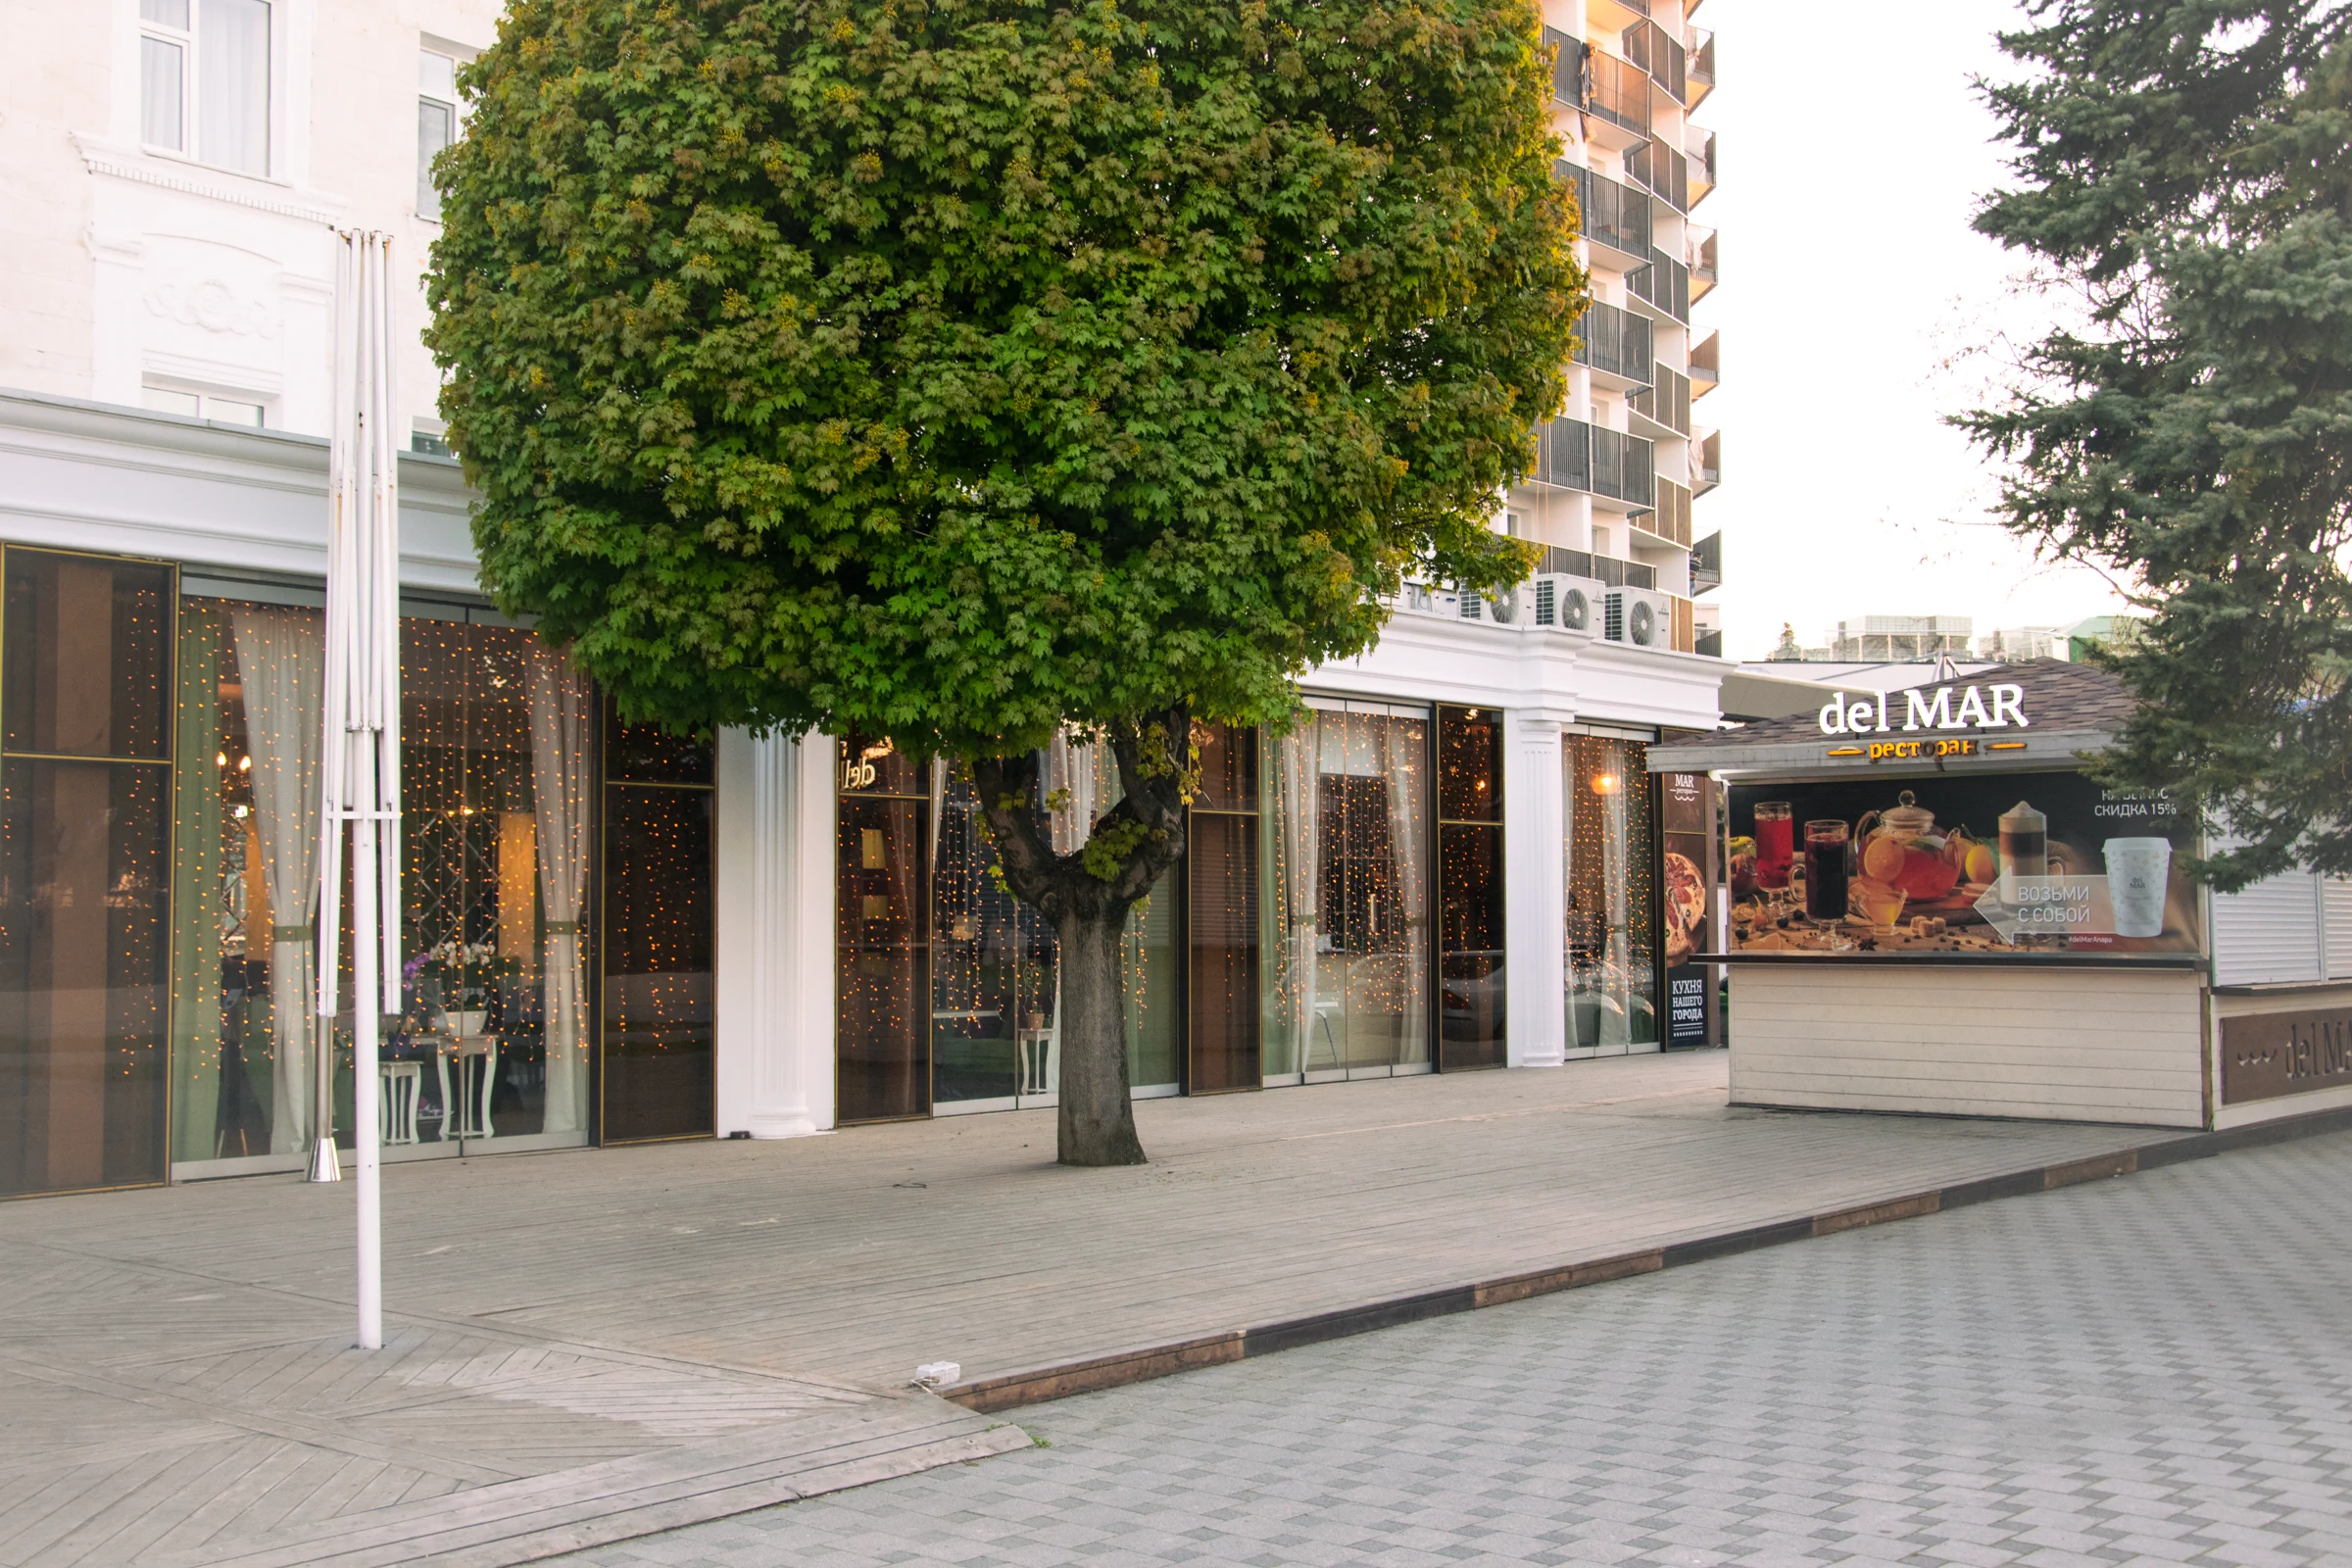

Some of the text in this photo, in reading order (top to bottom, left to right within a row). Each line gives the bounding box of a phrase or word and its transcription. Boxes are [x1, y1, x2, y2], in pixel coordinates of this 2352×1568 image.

[1819, 684, 2030, 735] del MAR
[1868, 739, 1979, 761] ресторан
[1674, 773, 1694, 789] MAR
[2094, 803, 2177, 818] СКИДКА 15%
[2018, 886, 2089, 902] ВОЗЬМИ
[2018, 905, 2090, 923] С СОБОЙ
[1672, 979, 1703, 995] КУХНЯ
[1672, 996, 1703, 1007] НАШЕГО
[1672, 1008, 1703, 1021] ГОРОДА
[2284, 1022, 2320, 1081] del
